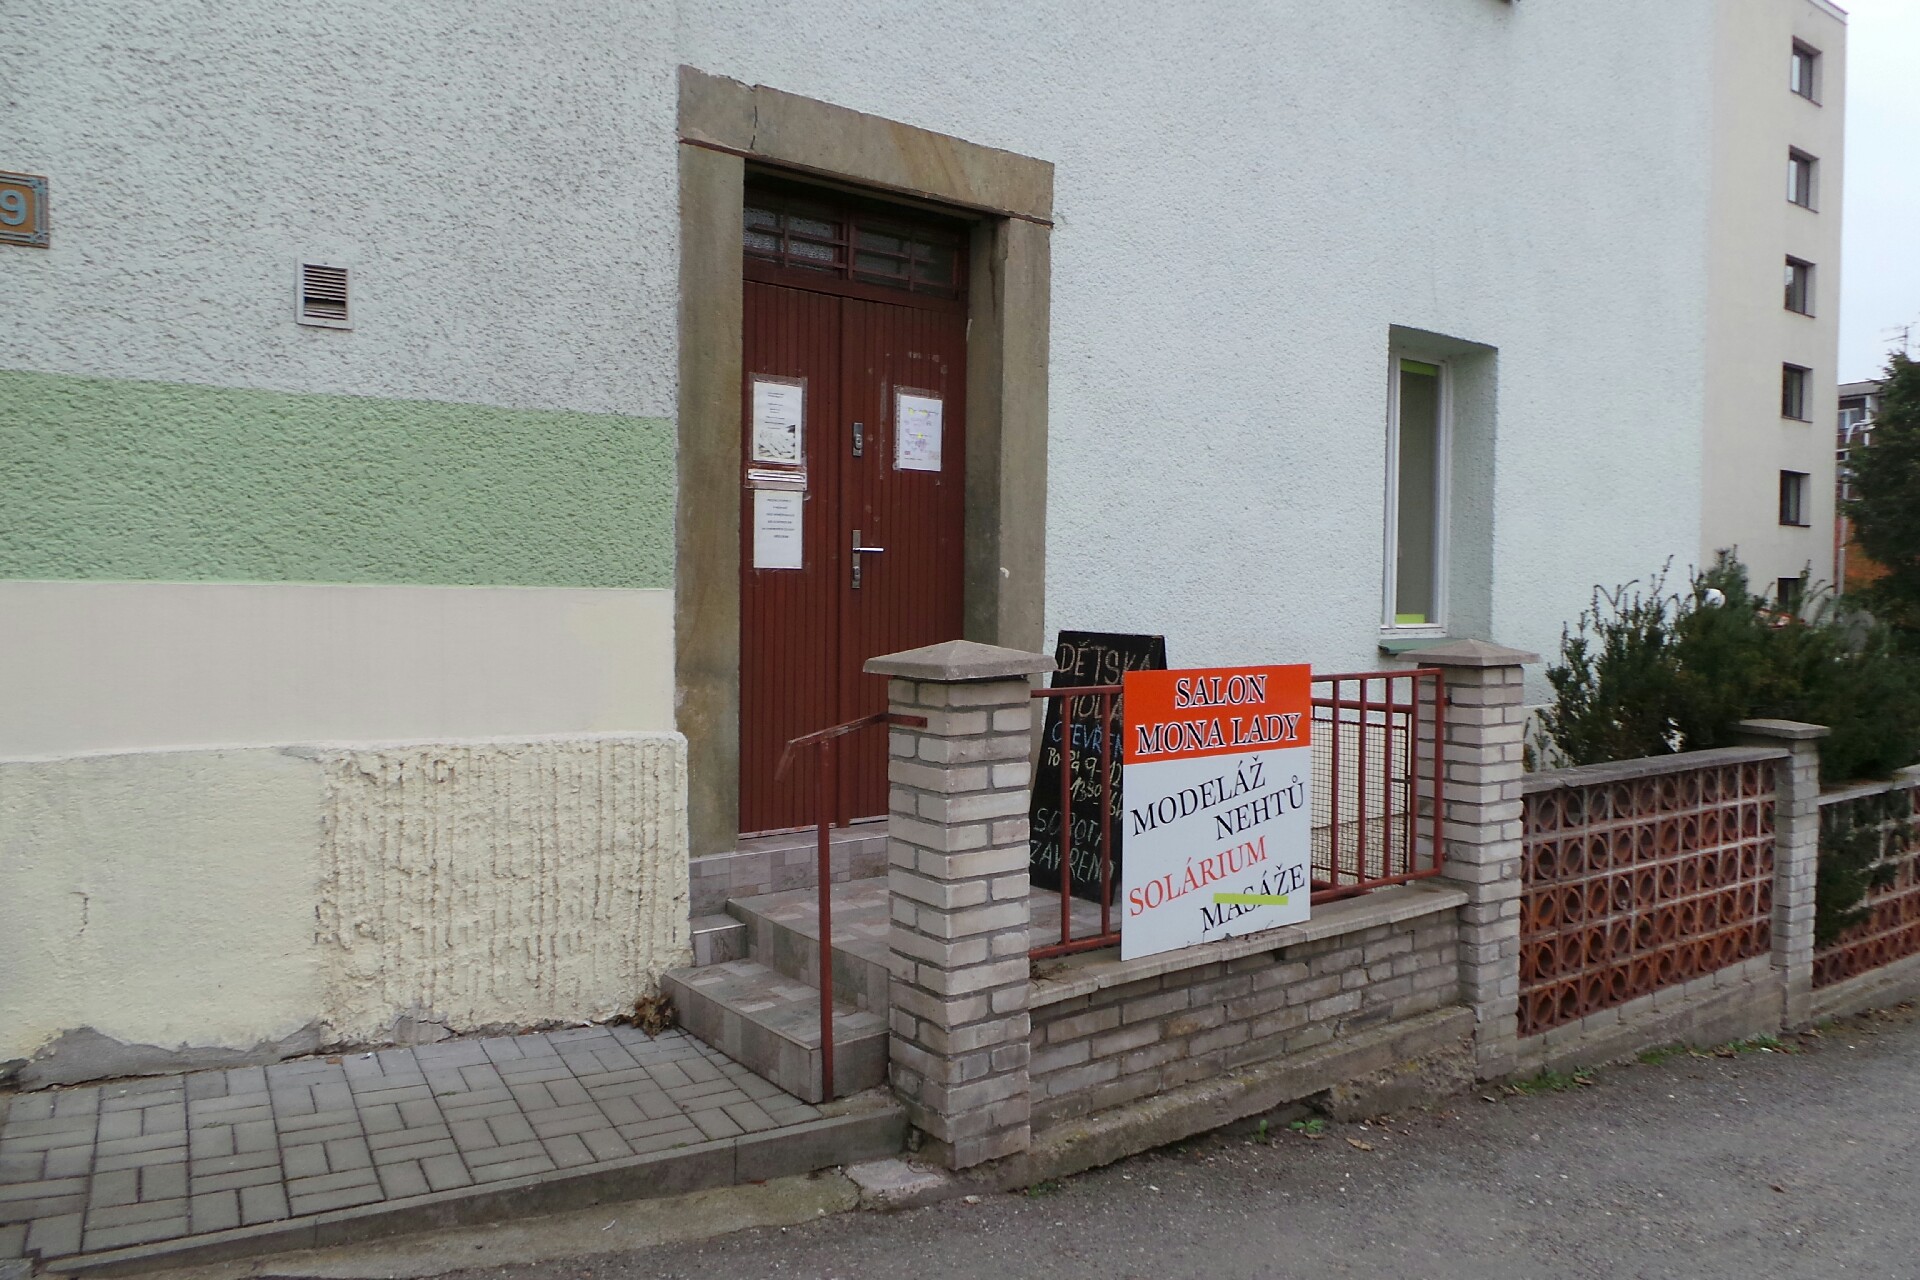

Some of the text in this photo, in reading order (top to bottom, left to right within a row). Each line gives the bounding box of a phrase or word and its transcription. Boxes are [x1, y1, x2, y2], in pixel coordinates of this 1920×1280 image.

[0, 189, 27, 226] 9
[1175, 674, 1267, 709] SALON
[1135, 713, 1301, 755] MONA LADY
[1130, 755, 1266, 837] MODELÁŽ
[1213, 775, 1305, 841] NEHTŮ
[1129, 835, 1267, 917] SOLÁRIUM
